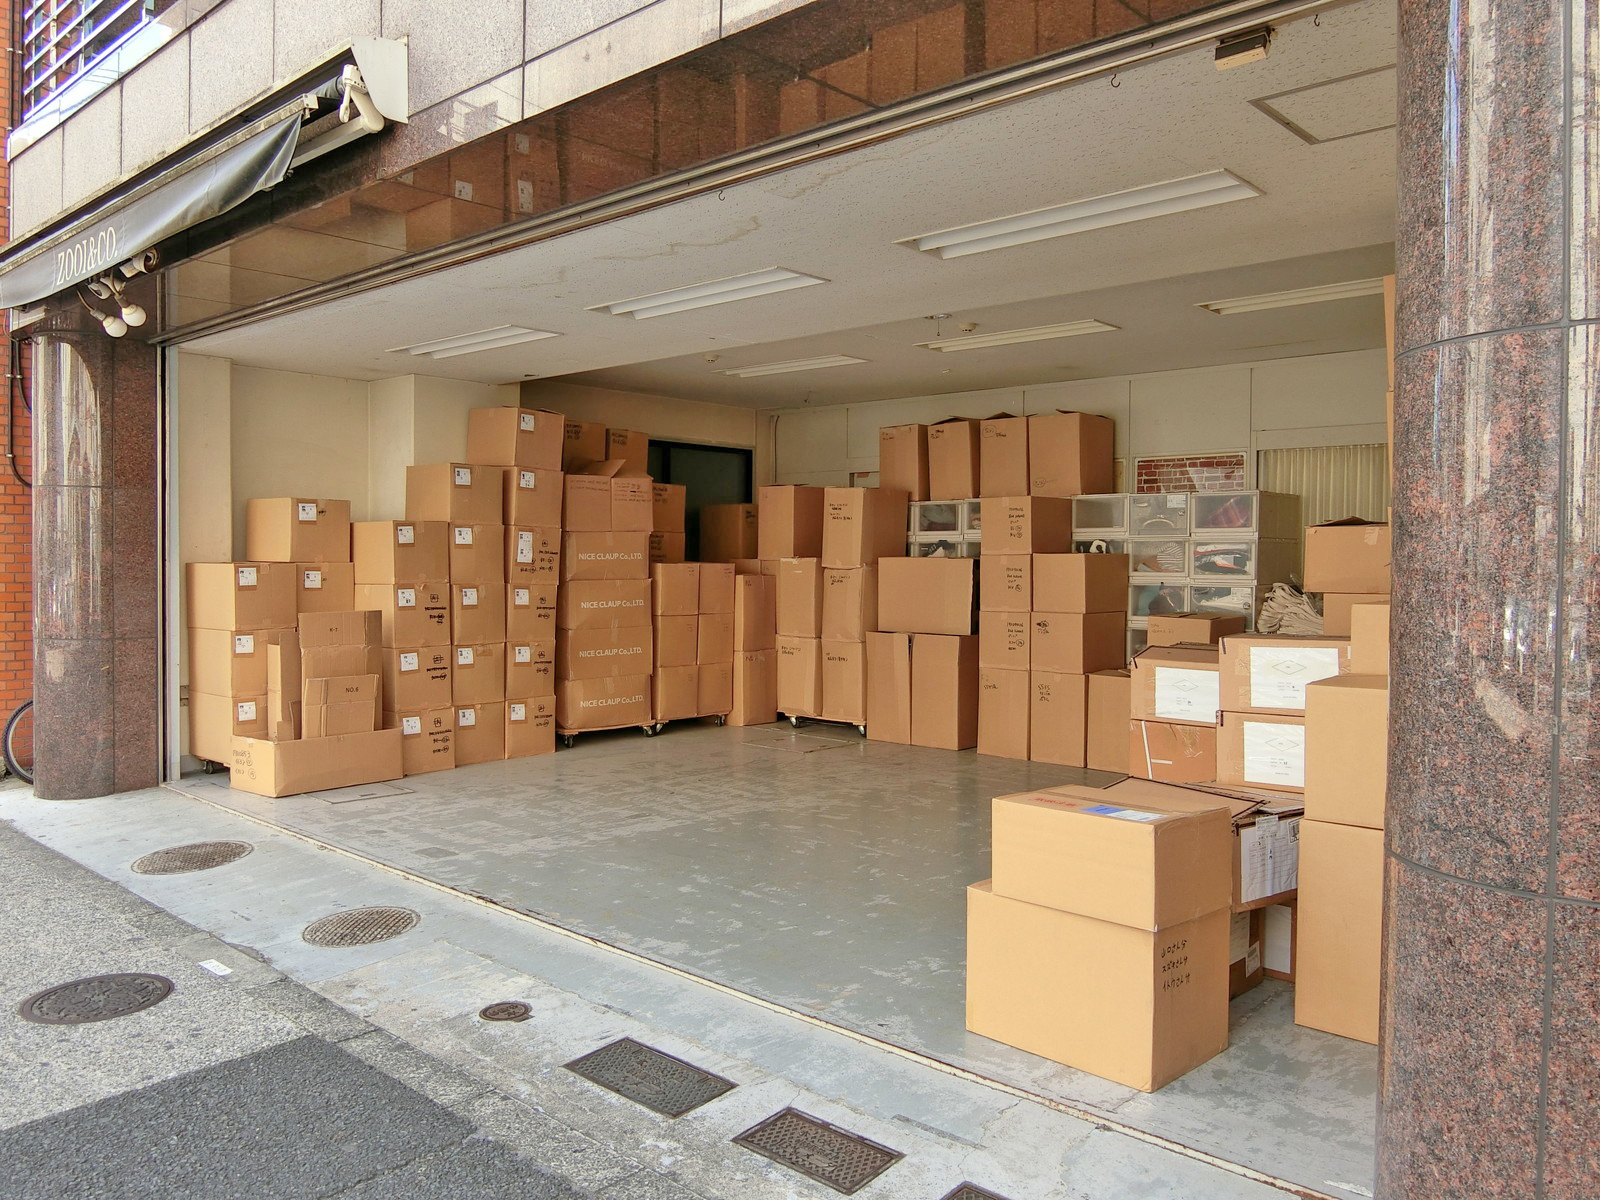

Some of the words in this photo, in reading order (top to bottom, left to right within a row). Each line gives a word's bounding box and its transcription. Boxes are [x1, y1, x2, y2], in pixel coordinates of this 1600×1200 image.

[596, 552, 619, 560] CLAUP
[599, 600, 621, 608] CLAUP
[579, 650, 595, 658] NICE
[595, 648, 618, 657] CLAUP
[580, 699, 597, 708] NICE
[598, 697, 621, 706] CLAUP
